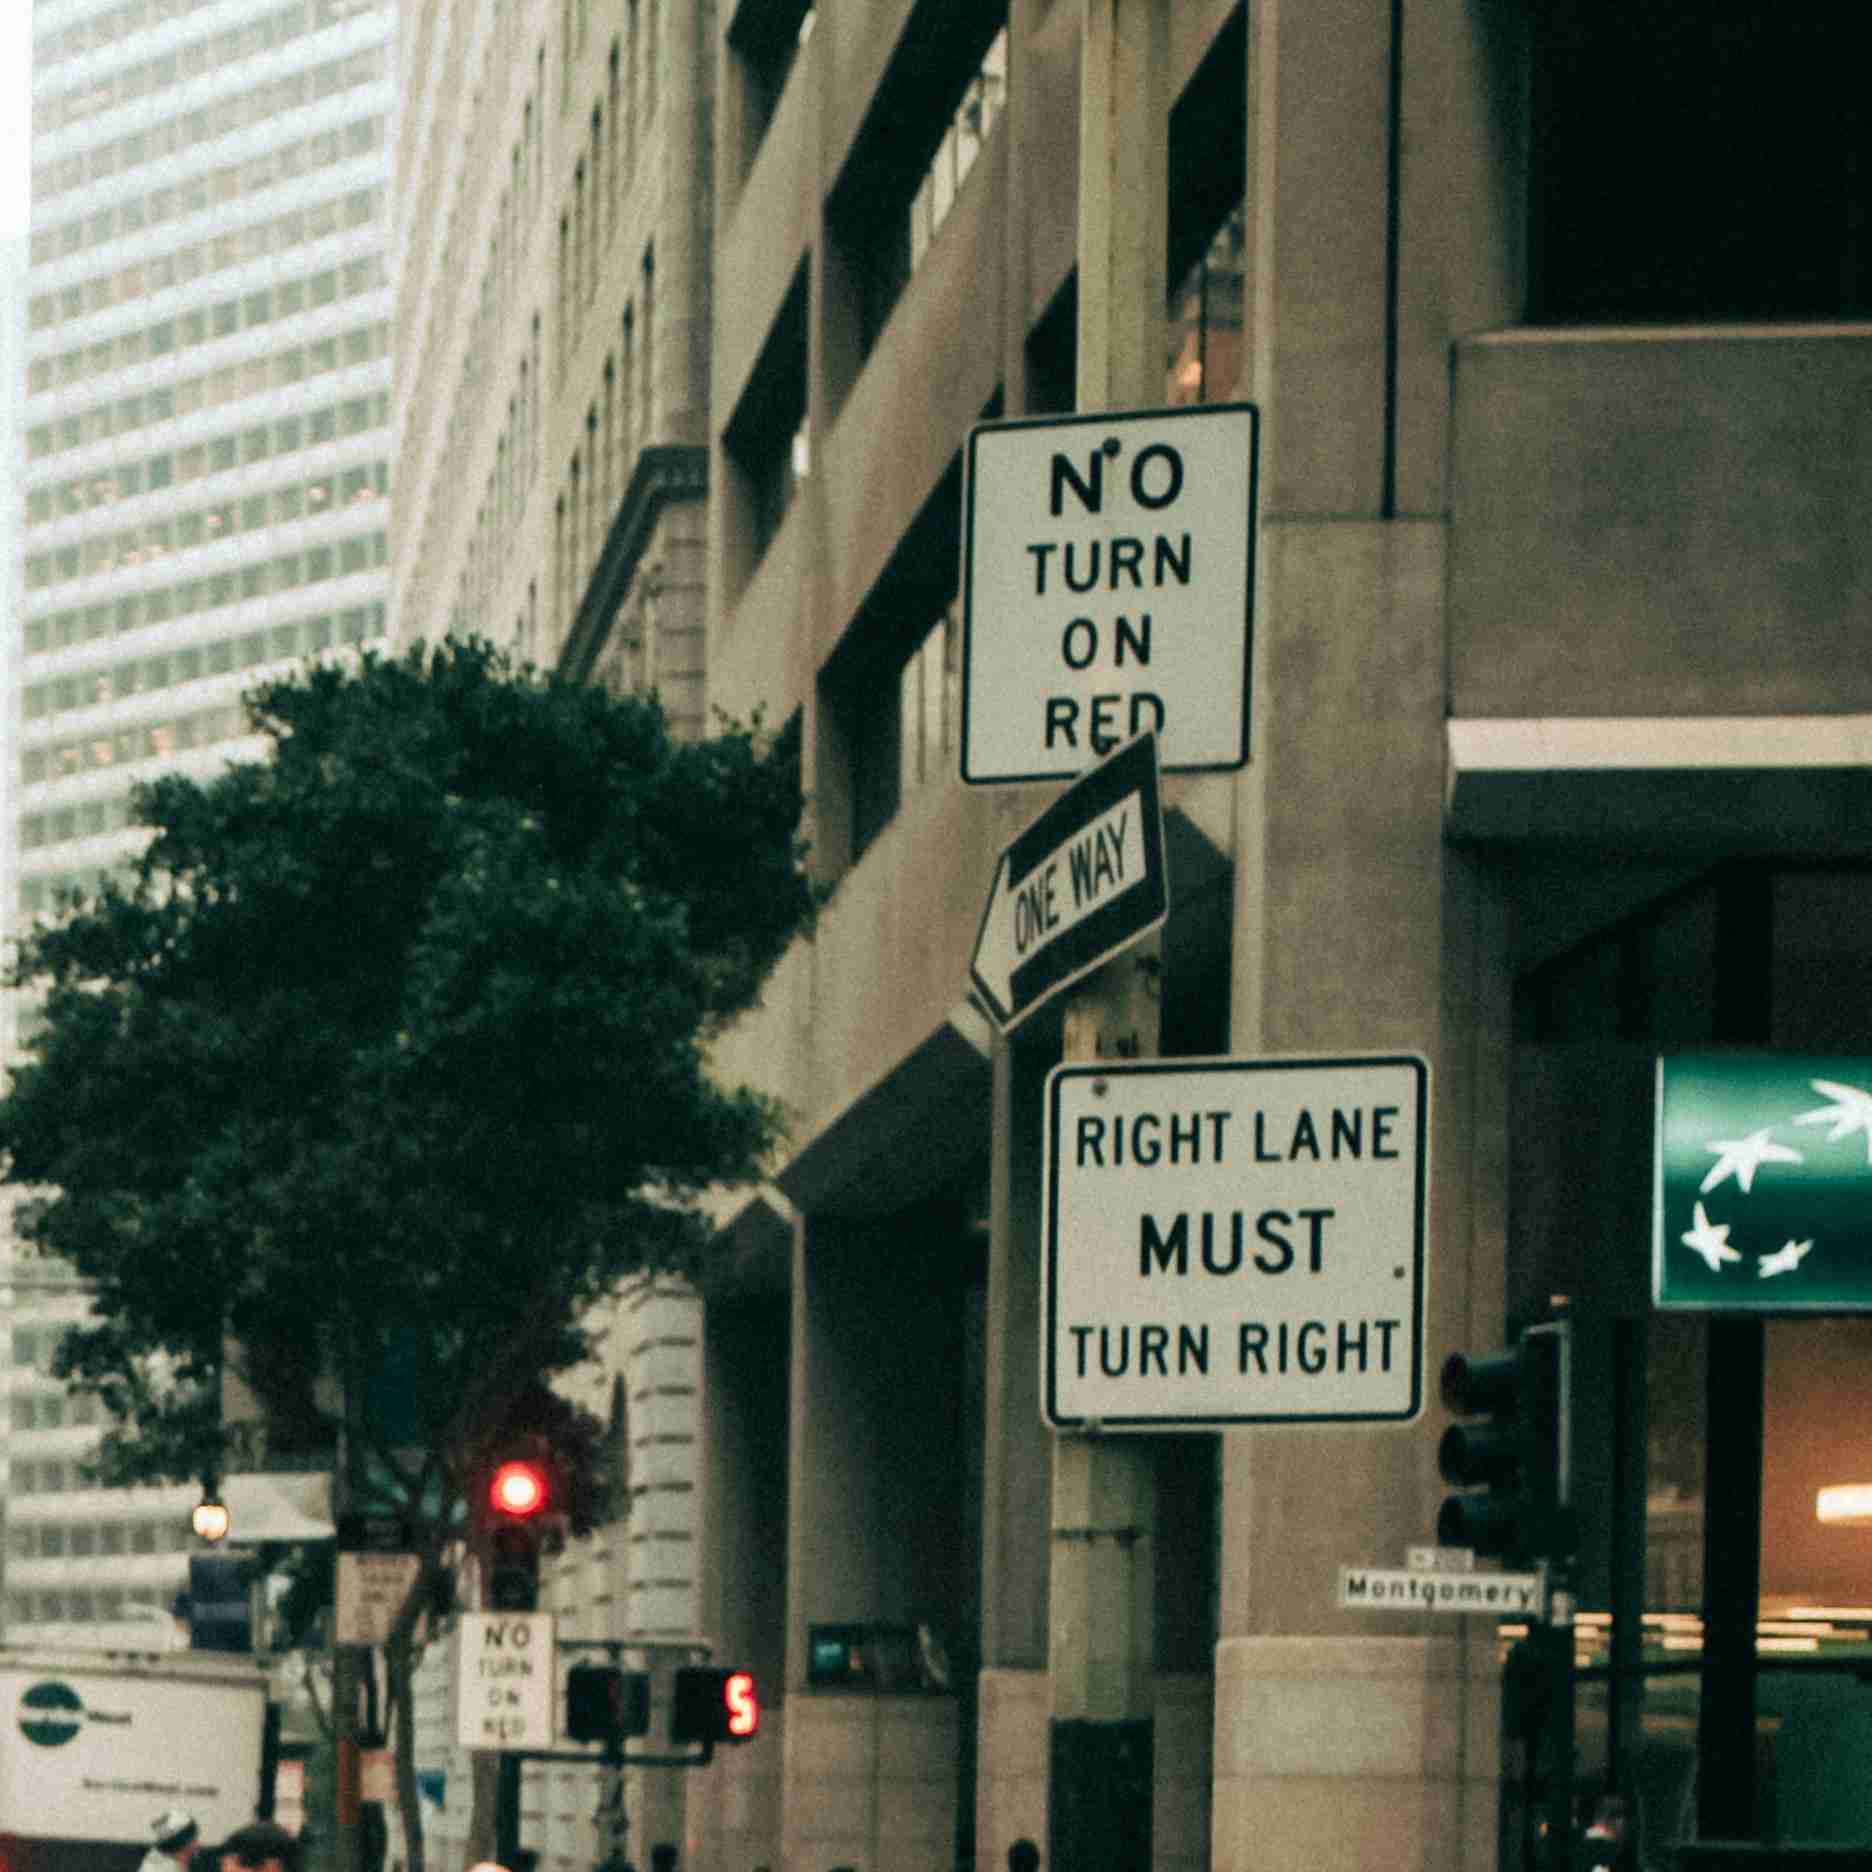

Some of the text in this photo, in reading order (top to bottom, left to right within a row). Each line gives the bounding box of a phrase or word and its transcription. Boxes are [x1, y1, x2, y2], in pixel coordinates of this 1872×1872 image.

[1049, 442, 1185, 516] NO
[1026, 532, 1192, 596] TURN
[1061, 614, 1152, 670] ON
[1044, 692, 1165, 750] RED
[1015, 811, 1128, 955] ONE WAY
[1076, 1106, 1400, 1168] RIGHT LANE
[1139, 1208, 1336, 1277] MUST
[1068, 1319, 1402, 1379] TURN RIGHT
[1347, 1573, 1535, 1609] Montgomery
[484, 1622, 531, 1649] NO
[479, 1658, 534, 1679] TURN
[487, 1685, 521, 1708] ON
